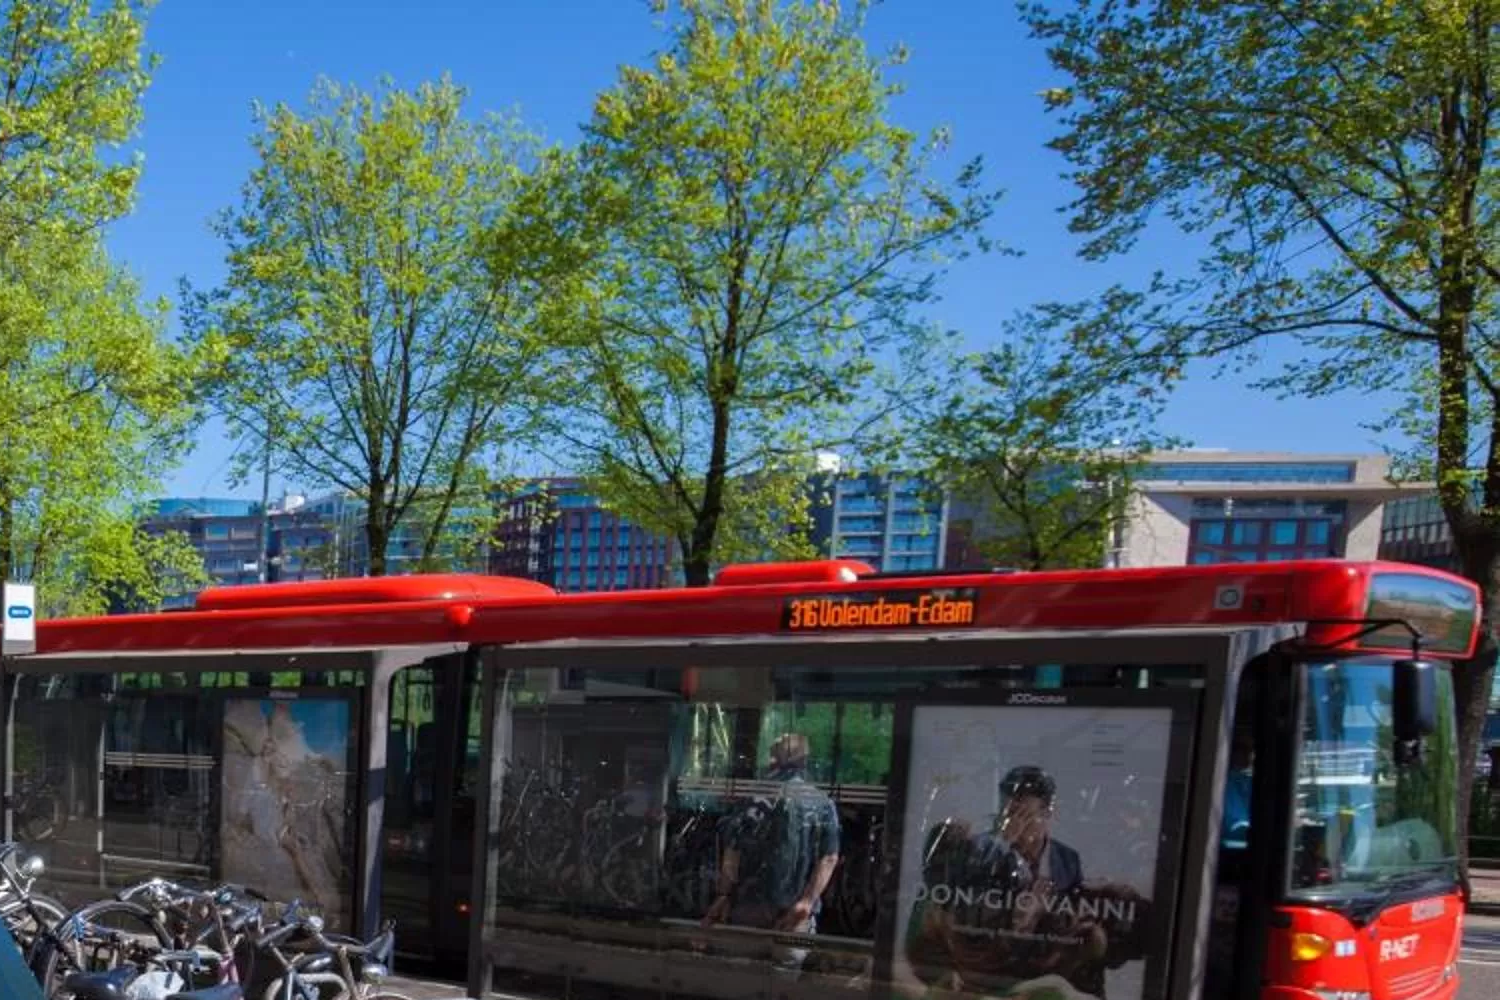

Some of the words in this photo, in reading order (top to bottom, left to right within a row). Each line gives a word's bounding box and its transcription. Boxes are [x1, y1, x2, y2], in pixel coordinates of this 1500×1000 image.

[788, 599, 818, 628] 316
[913, 883, 974, 908] DON
[986, 888, 1137, 922] GIOVANNI
